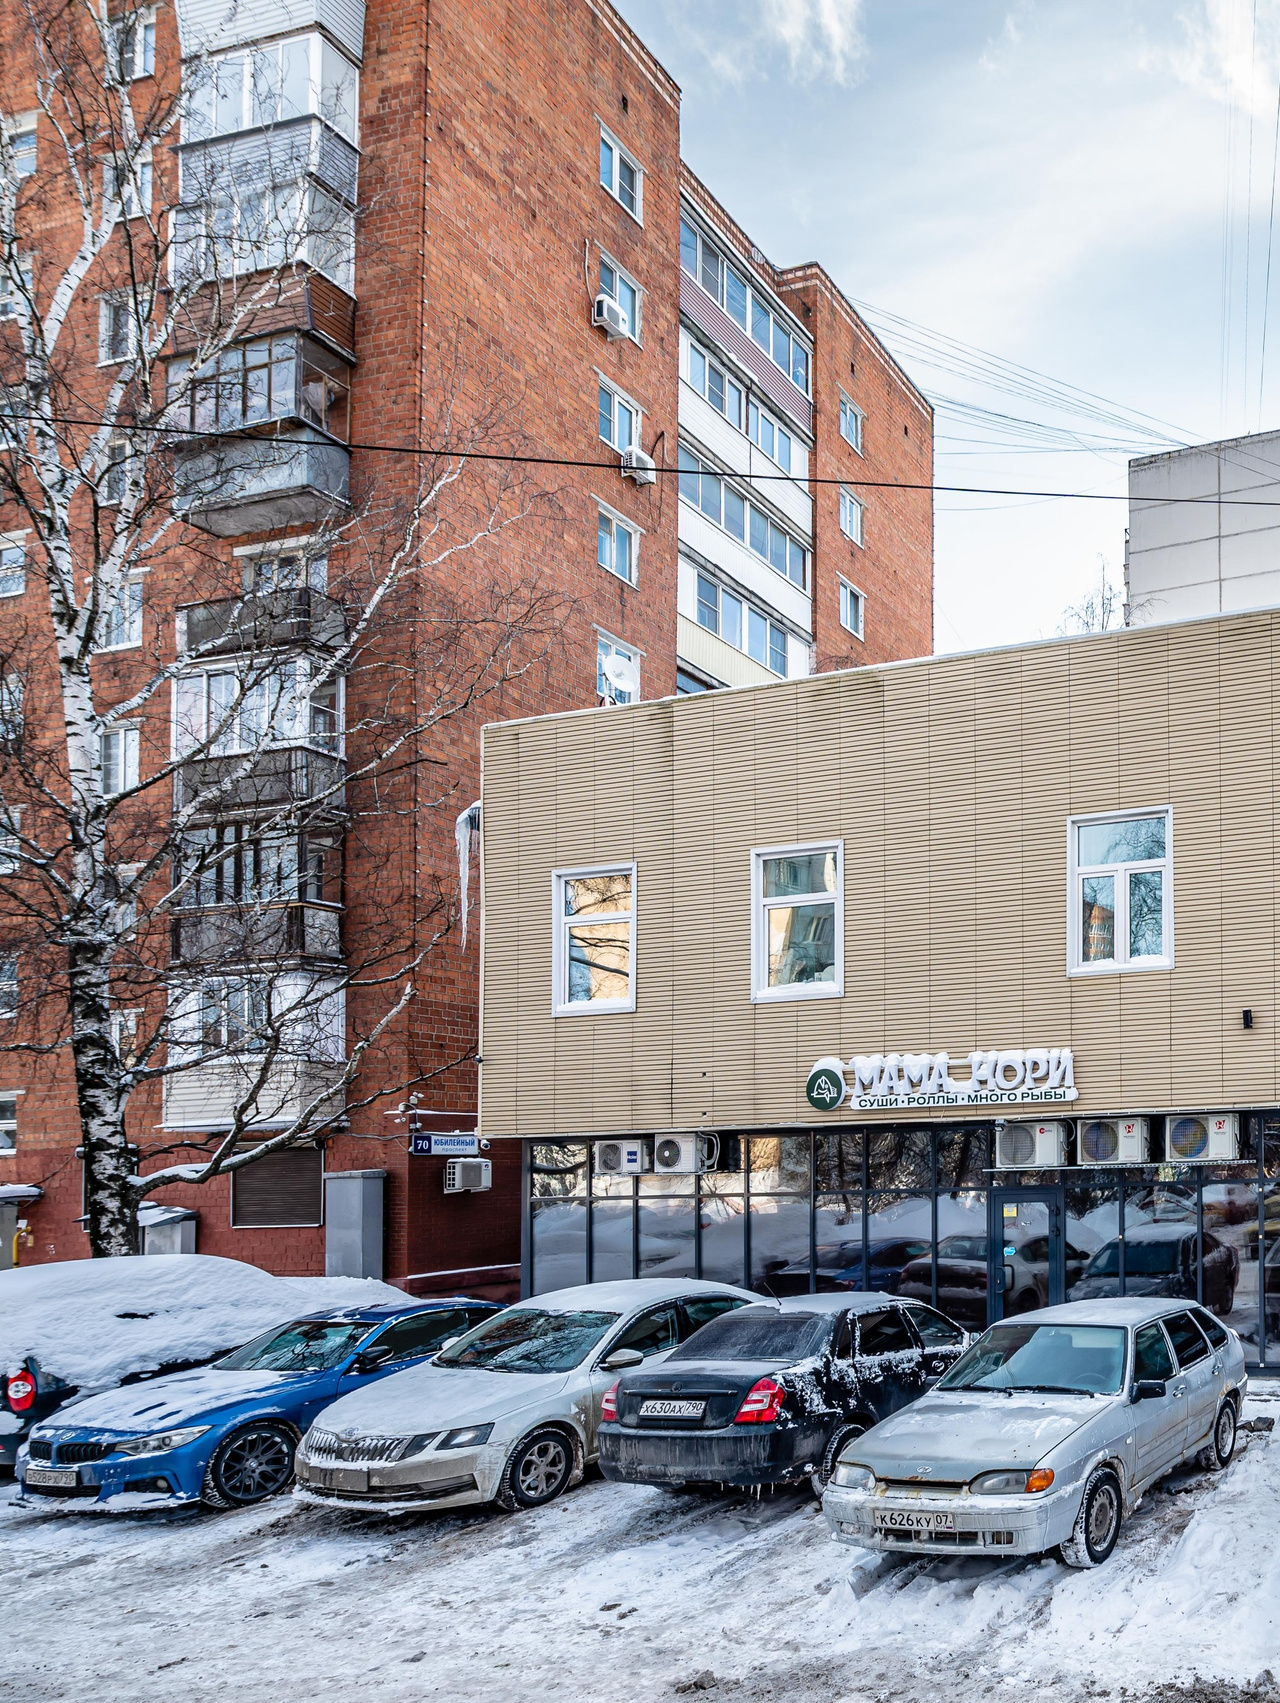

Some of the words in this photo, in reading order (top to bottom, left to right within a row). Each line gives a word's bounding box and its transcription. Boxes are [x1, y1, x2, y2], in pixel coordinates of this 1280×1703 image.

[854, 1058, 951, 1097] МАМА
[971, 1053, 1075, 1091] НОРИ
[858, 1097, 898, 1108] СУШИ
[907, 1095, 958, 1105] РОЛЛЫ
[968, 1092, 1018, 1103] МНОГО
[1021, 1090, 1066, 1101] РЫБЫ
[416, 1140, 429, 1150] 70
[434, 1138, 475, 1147] ЮБИЛЕЙНЫЙ
[935, 1514, 948, 1525] 07
